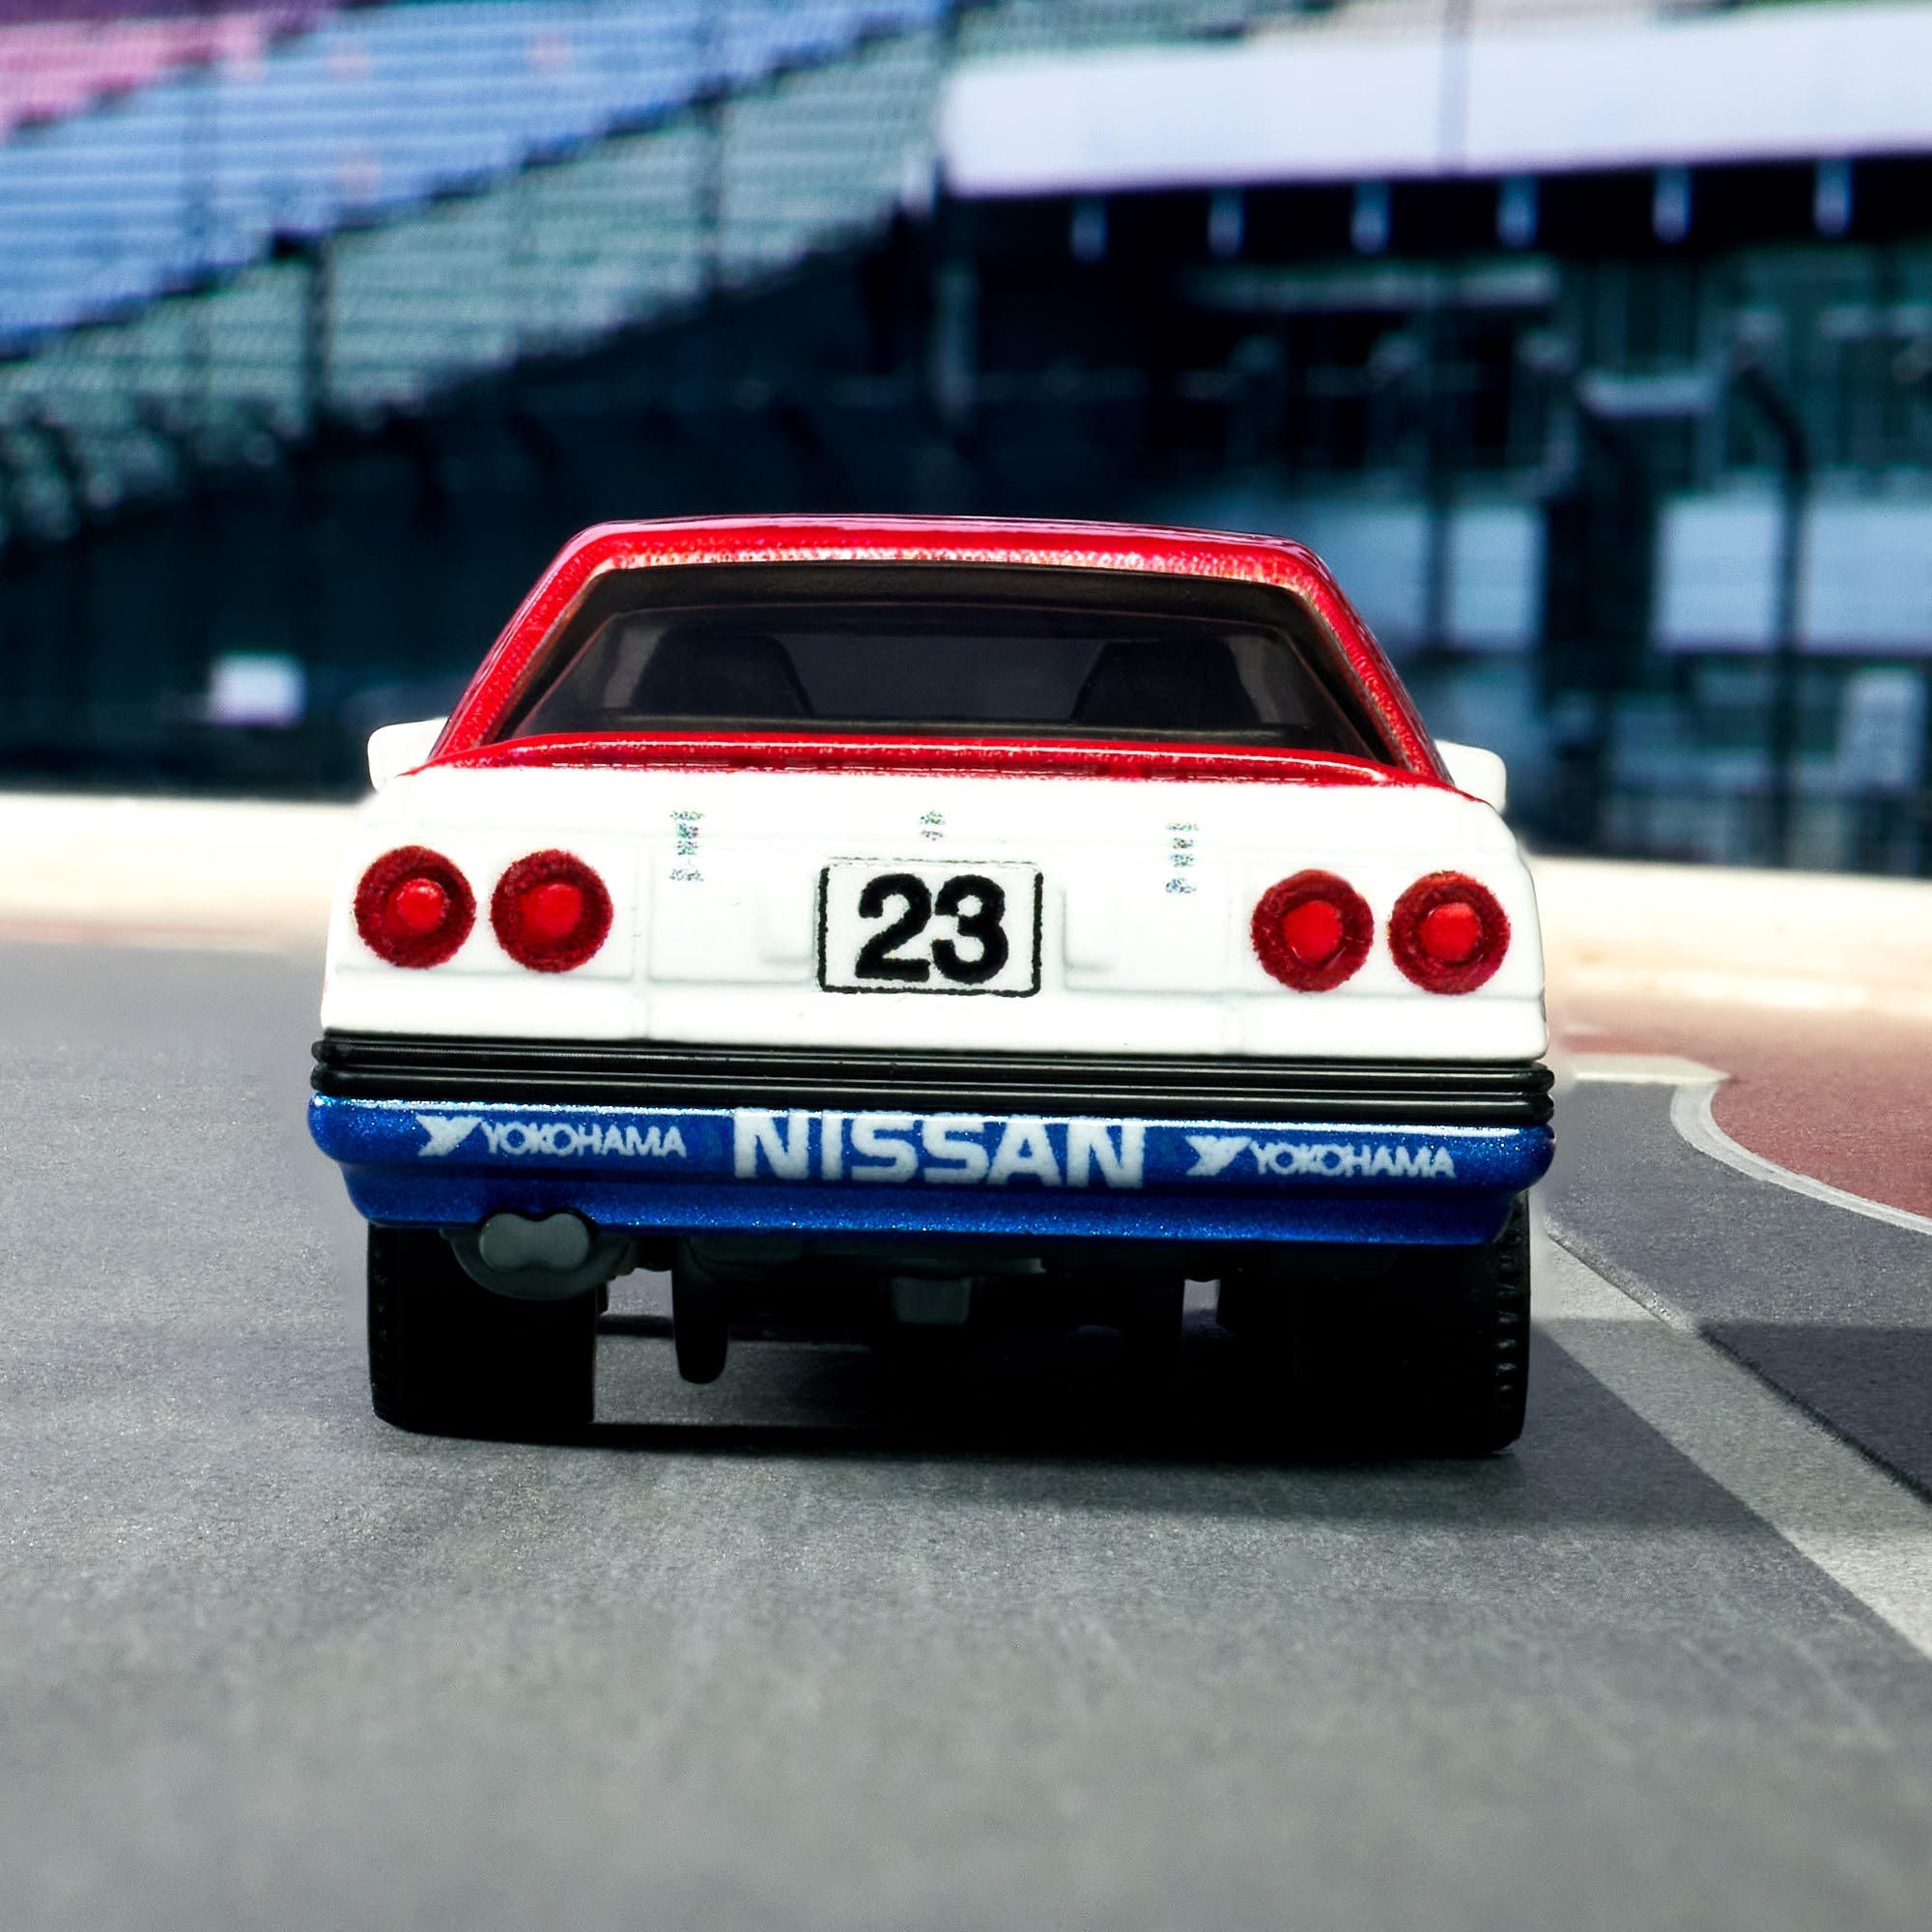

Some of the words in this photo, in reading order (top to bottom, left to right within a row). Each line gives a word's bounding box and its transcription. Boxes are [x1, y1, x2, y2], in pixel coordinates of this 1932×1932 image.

[856, 873, 1009, 984] 23
[482, 1122, 687, 1157] YOKOHAMA
[733, 1108, 1147, 1188] NISSAN
[1251, 1142, 1457, 1178] YOKOHAMA
